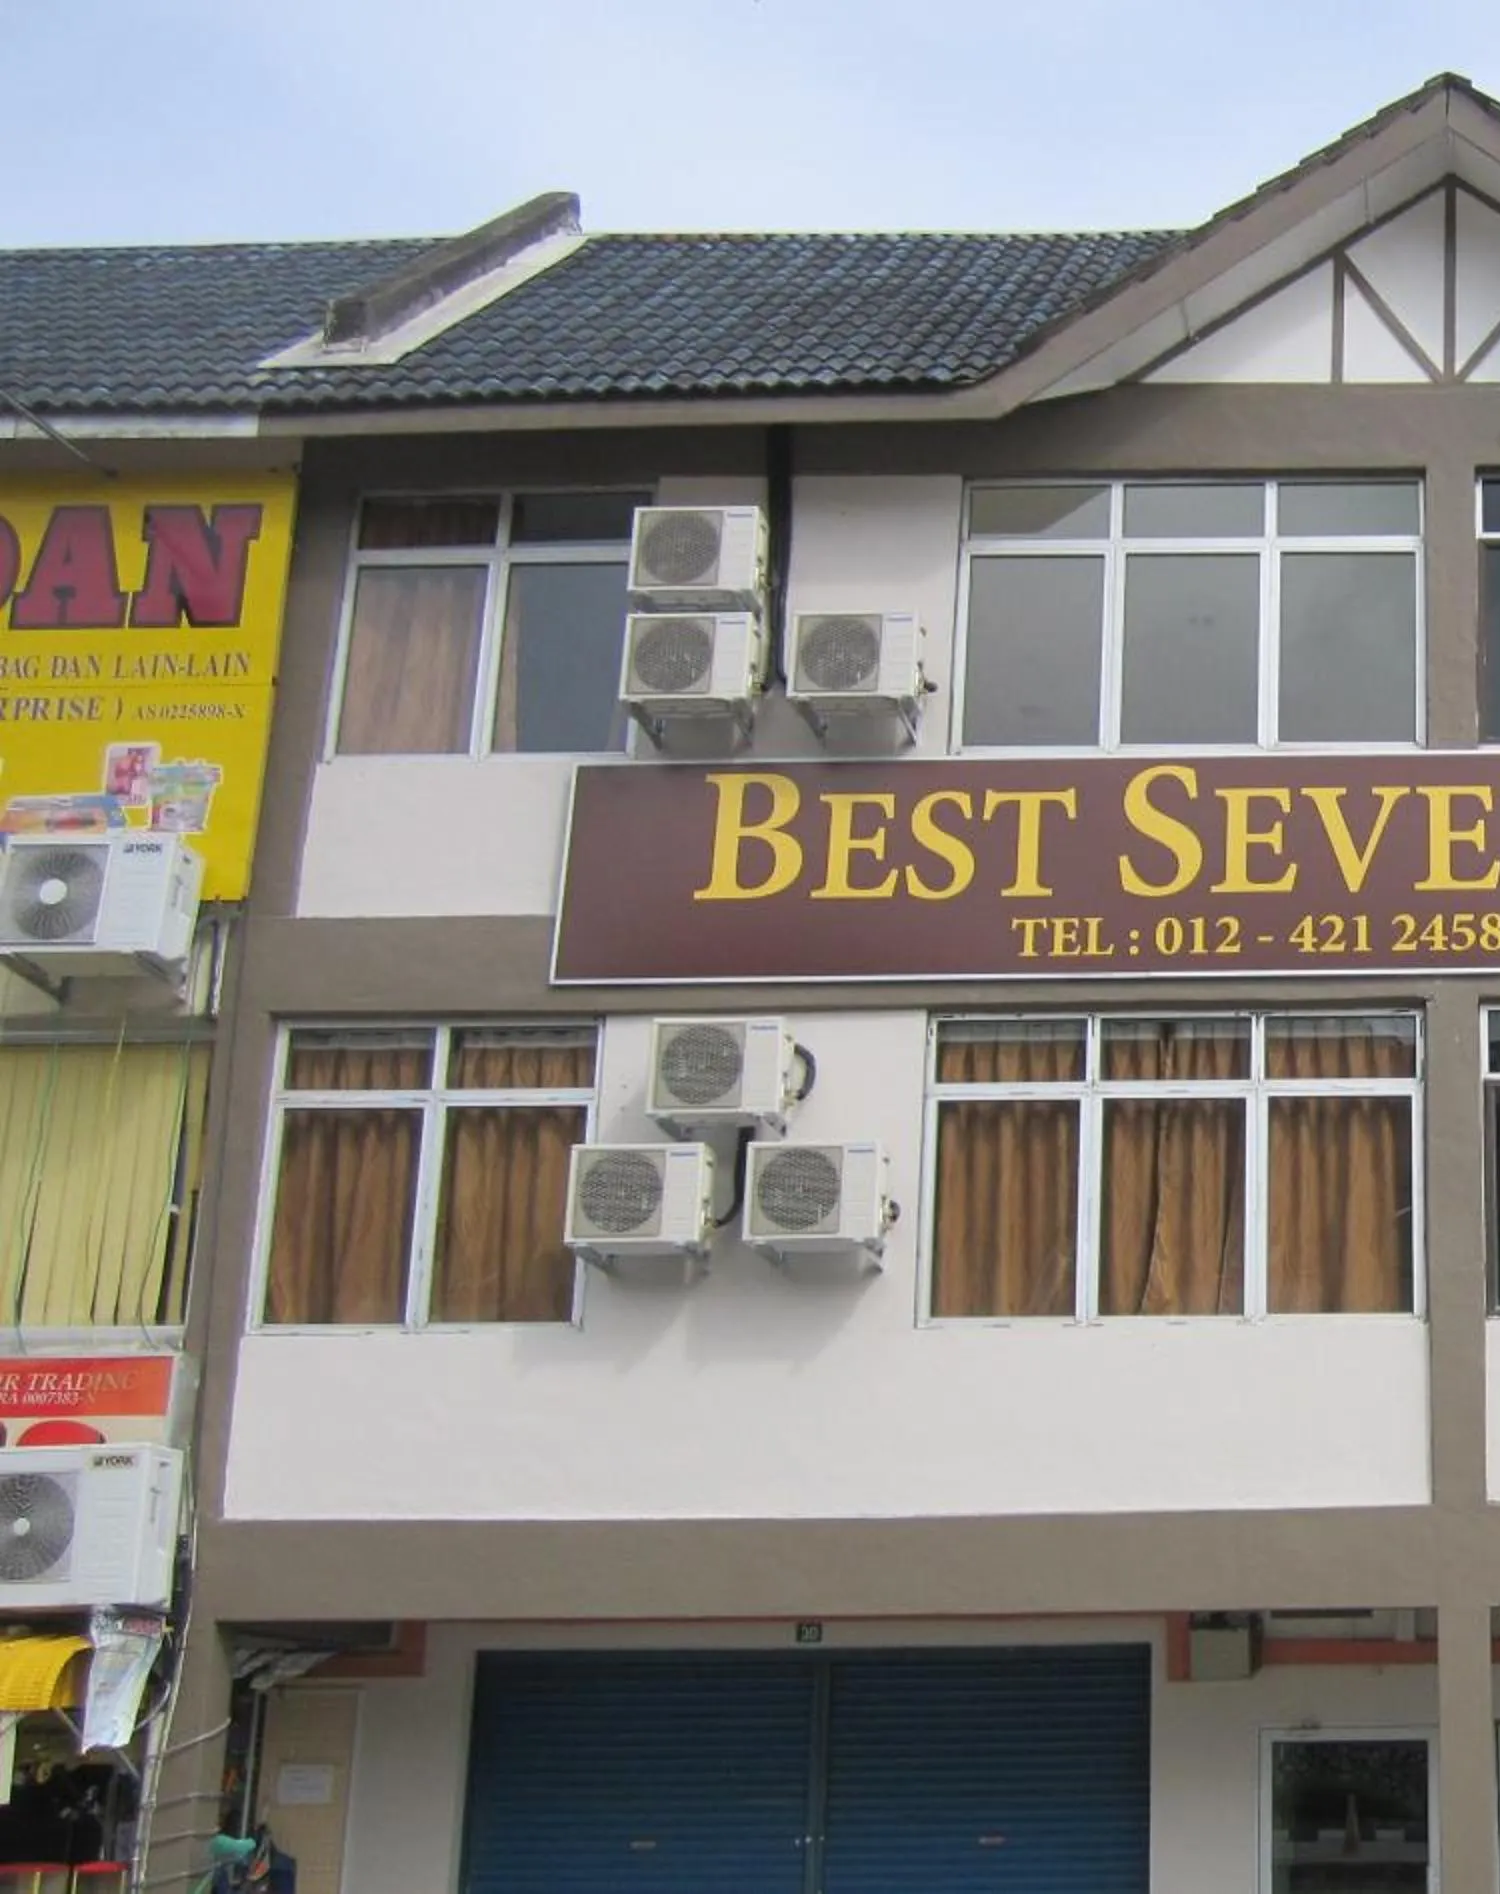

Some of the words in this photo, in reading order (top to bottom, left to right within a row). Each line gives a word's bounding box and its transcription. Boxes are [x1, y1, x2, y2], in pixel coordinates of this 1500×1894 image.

[0, 504, 264, 630] AN
[51, 655, 103, 680] DAN
[112, 653, 251, 679] LAIN-LAIN
[693, 773, 1077, 901] BEST
[1155, 915, 1242, 955] 012
[1288, 914, 1373, 953] 421
[28, 1371, 137, 1392] TRADING
[104, 1455, 135, 1467] YORK
